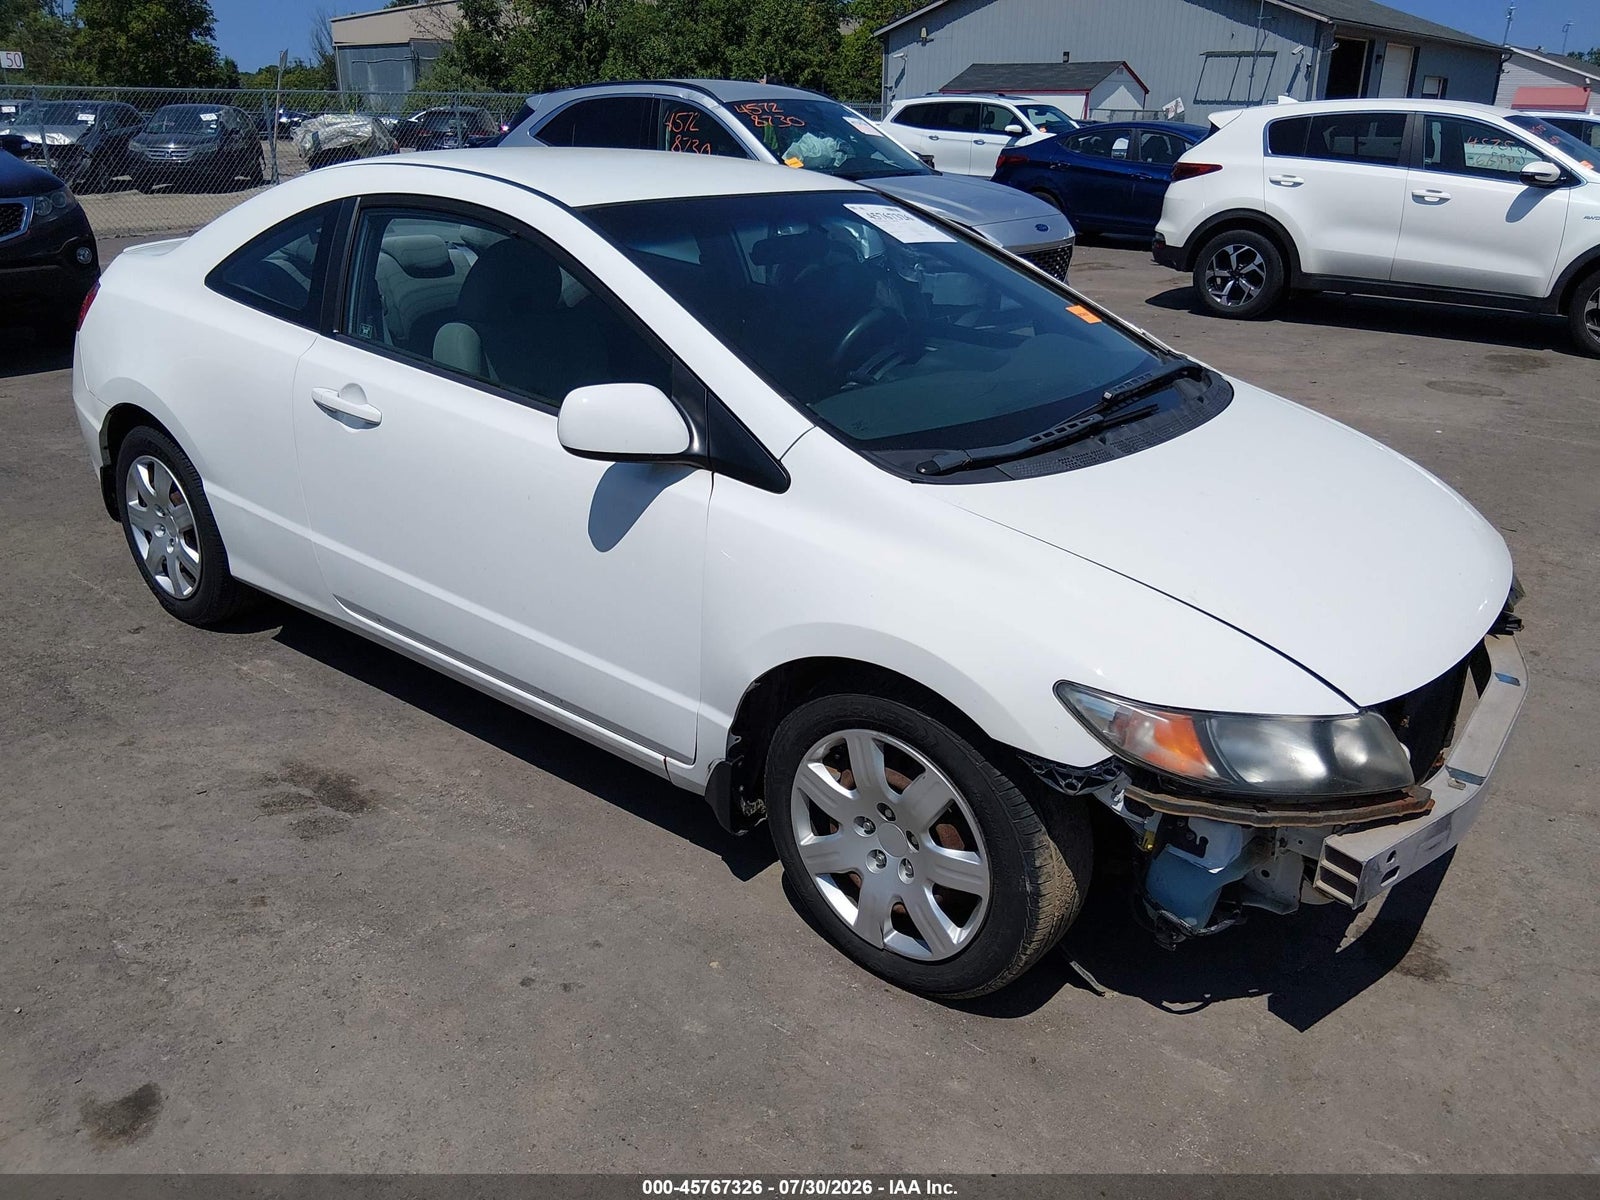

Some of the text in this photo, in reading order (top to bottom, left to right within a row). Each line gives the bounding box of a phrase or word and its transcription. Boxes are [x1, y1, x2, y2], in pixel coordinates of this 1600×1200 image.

[5, 52, 22, 68] 50
[734, 102, 784, 115] 4572
[664, 110, 700, 133] 4572
